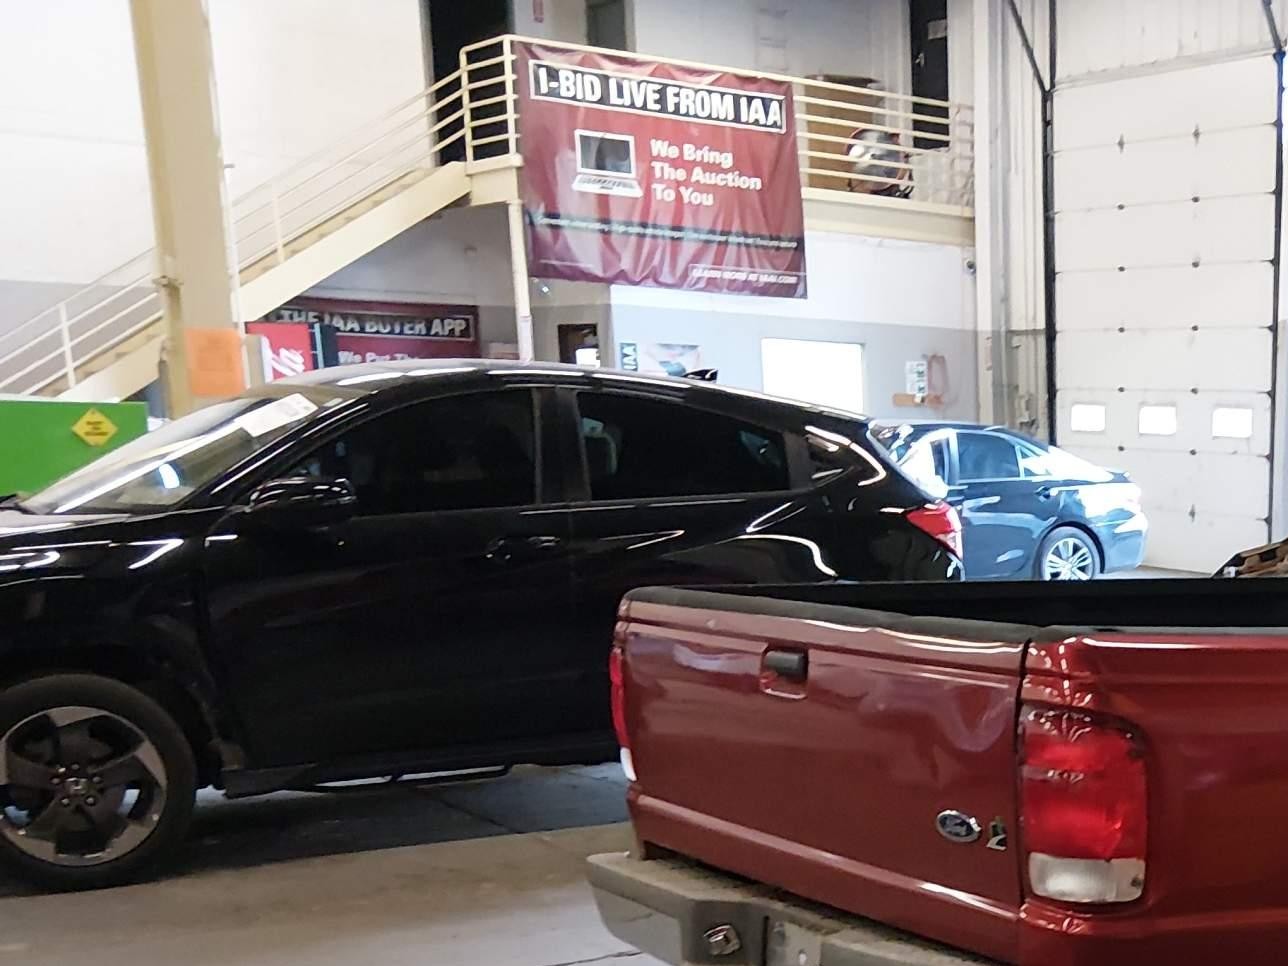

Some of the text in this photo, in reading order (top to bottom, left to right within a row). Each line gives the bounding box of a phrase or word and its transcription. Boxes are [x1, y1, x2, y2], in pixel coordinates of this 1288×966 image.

[539, 67, 782, 126] I-BID LIVE FROM IAA
[650, 139, 733, 169] We Bring
[651, 161, 762, 190] The Auction
[651, 183, 714, 206] To You
[430, 318, 467, 336] APP
